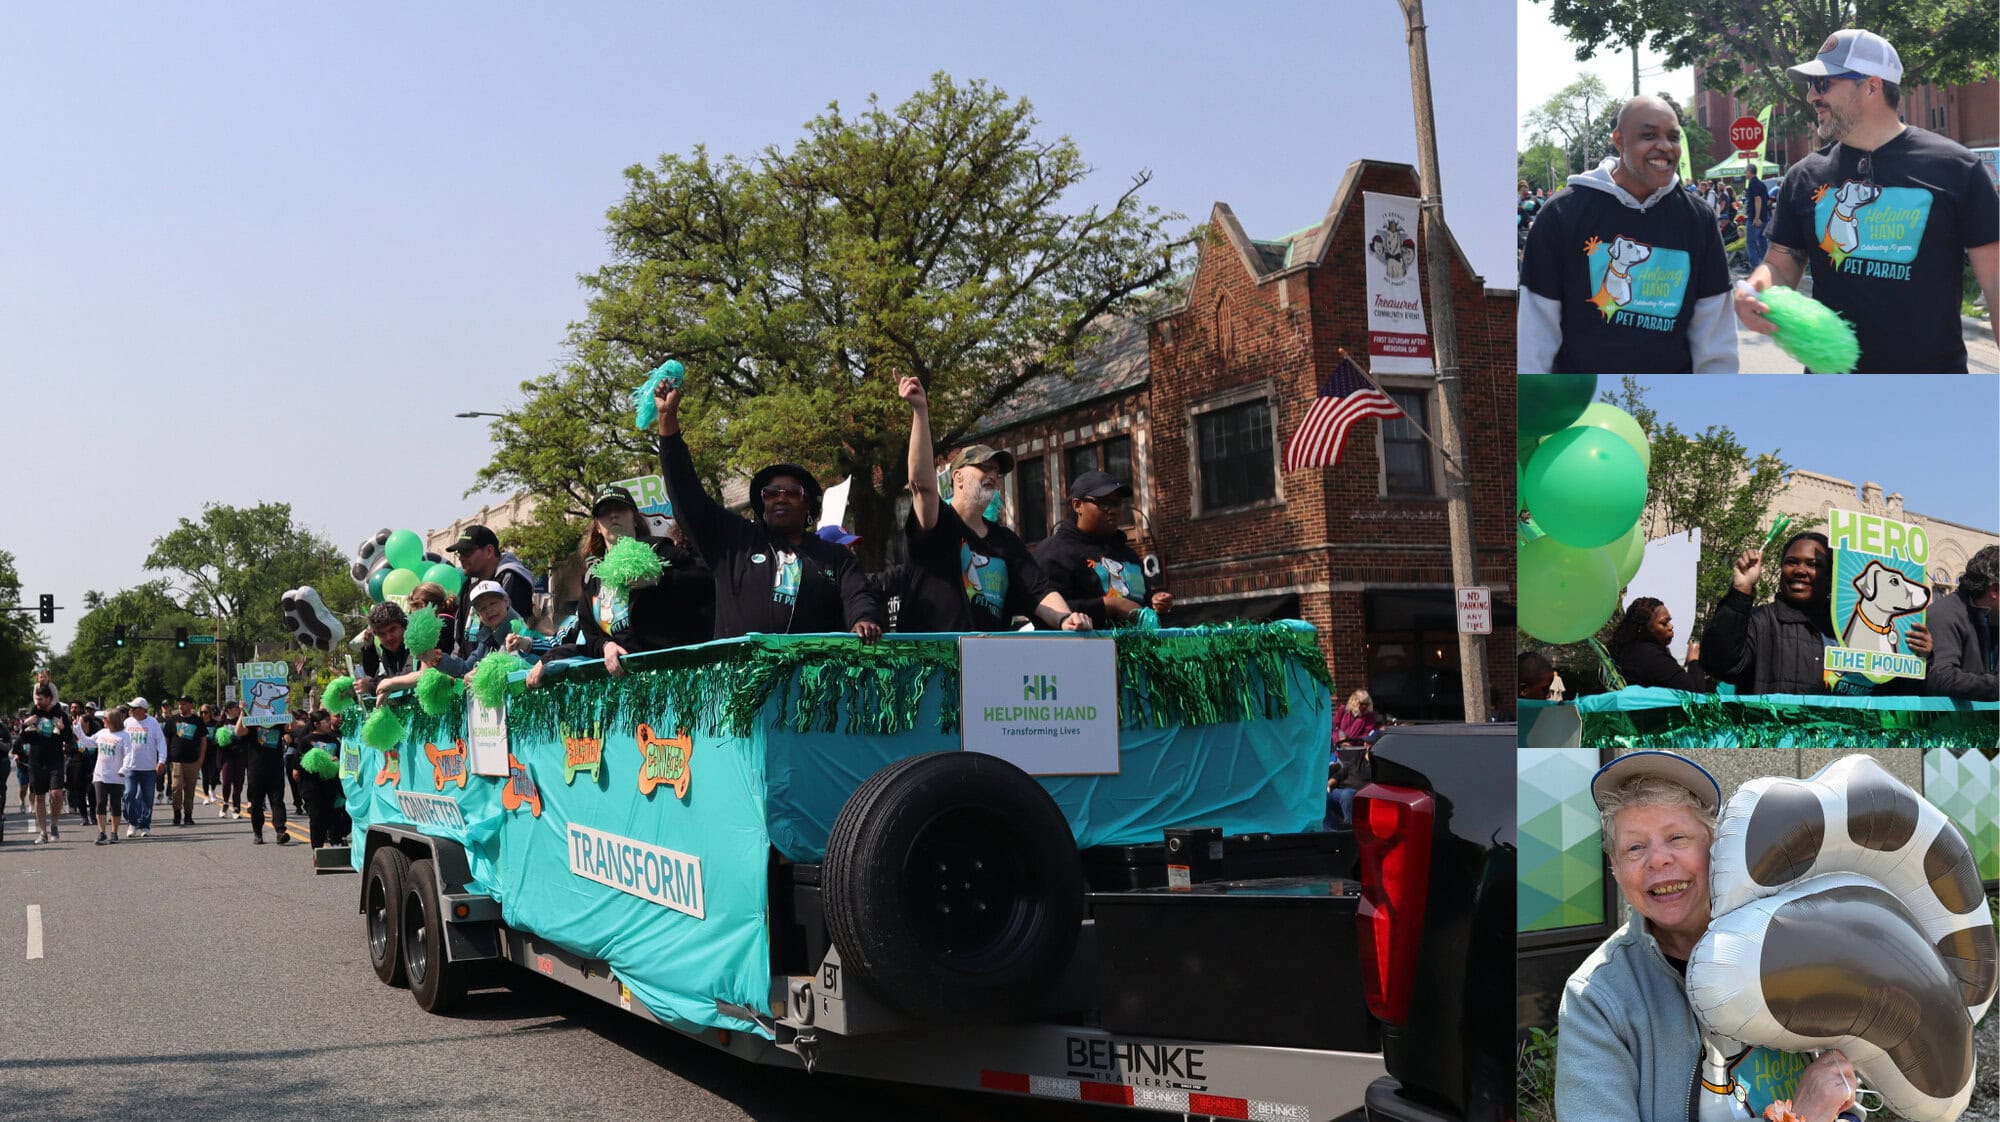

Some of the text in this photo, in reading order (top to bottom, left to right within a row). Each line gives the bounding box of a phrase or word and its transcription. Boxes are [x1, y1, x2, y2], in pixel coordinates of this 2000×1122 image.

[1732, 127, 1761, 140] STOP
[1864, 205, 1920, 229] Helping
[1870, 224, 1905, 240] HAND
[1637, 266, 1683, 288] Helping
[1844, 258, 1912, 281] PET PARADE
[1642, 282, 1671, 298] HAND
[1375, 294, 1419, 310] Treasured
[1374, 310, 1420, 320] COMMUNITY EVENT
[1615, 311, 1676, 332] PET PARADE
[1831, 510, 1929, 564] HERO
[1467, 592, 1480, 600] NO
[1460, 601, 1488, 610] PARKING
[238, 662, 288, 679] HERO
[1832, 650, 1923, 675] THE HOUND
[984, 706, 1097, 722] HELPING HAND
[1002, 726, 1081, 737] Transforming Lives
[398, 795, 463, 830] CONNECTED
[570, 829, 698, 910] TRANSFORM
[1066, 1037, 1207, 1081] BEHNKE
[1038, 1078, 1073, 1091] BEHNKE
[1095, 1072, 1172, 1088] TRAILERS
[1143, 1090, 1180, 1103] BEHNKE
[1259, 1103, 1299, 1118] BEHNKE
